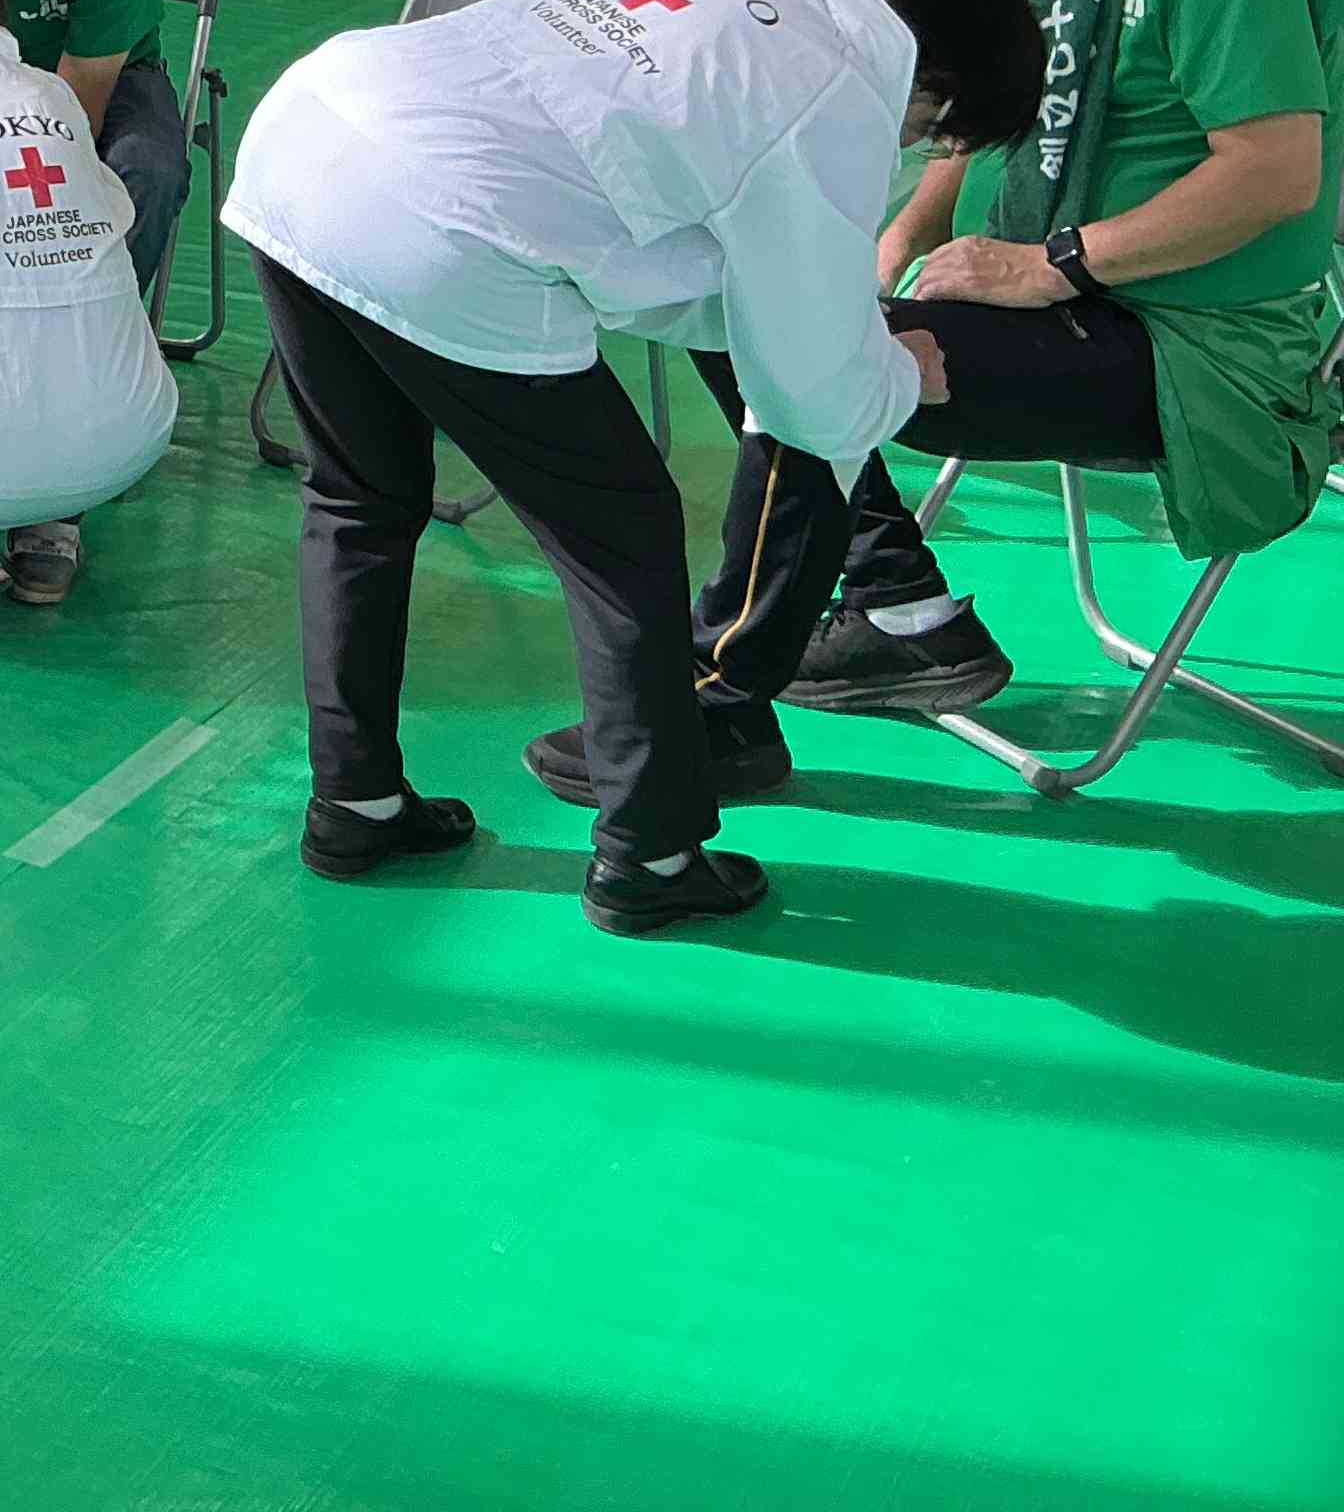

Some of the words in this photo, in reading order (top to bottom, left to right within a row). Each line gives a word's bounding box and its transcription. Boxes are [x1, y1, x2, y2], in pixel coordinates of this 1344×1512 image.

[528, 0, 607, 57] Volunteer
[598, 21, 662, 77] SOCIETY
[6, 209, 83, 230] JAPANESE
[2, 227, 57, 244] CROSS
[62, 221, 114, 239] SOCIETY
[4, 247, 94, 268] Volunteer
